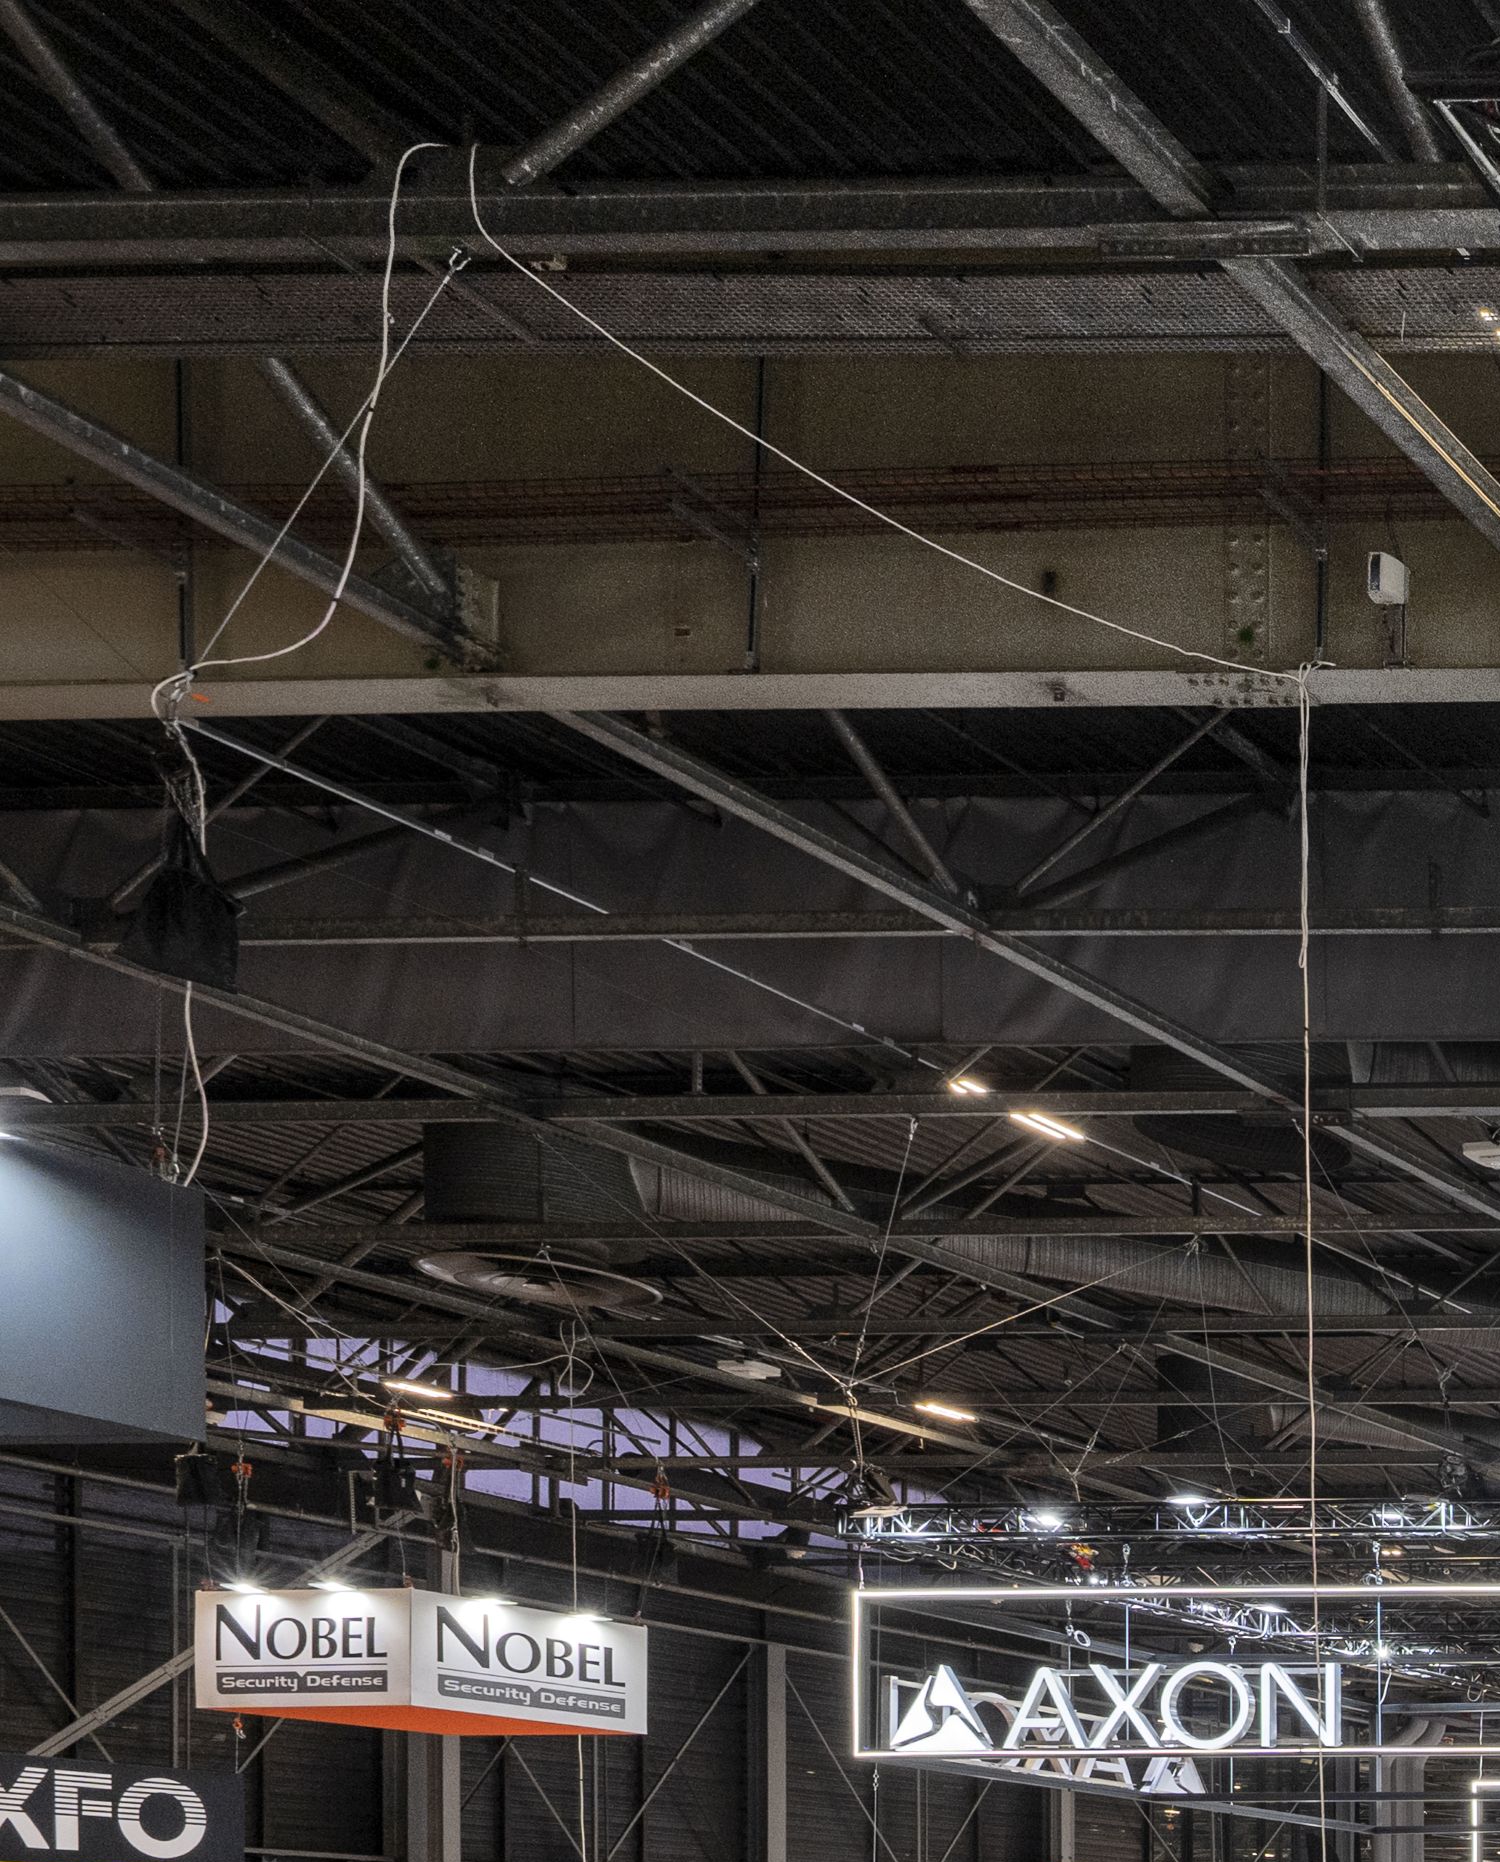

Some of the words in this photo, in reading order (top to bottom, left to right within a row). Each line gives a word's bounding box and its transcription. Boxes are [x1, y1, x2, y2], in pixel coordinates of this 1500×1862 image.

[216, 1604, 388, 1661] NOBEL
[437, 1605, 626, 1688] NOBEL
[222, 1675, 299, 1691] Security
[306, 1674, 383, 1687] Defense
[444, 1680, 531, 1705] Security
[541, 1692, 621, 1713] Defense
[1002, 1661, 1342, 1749] AXON
